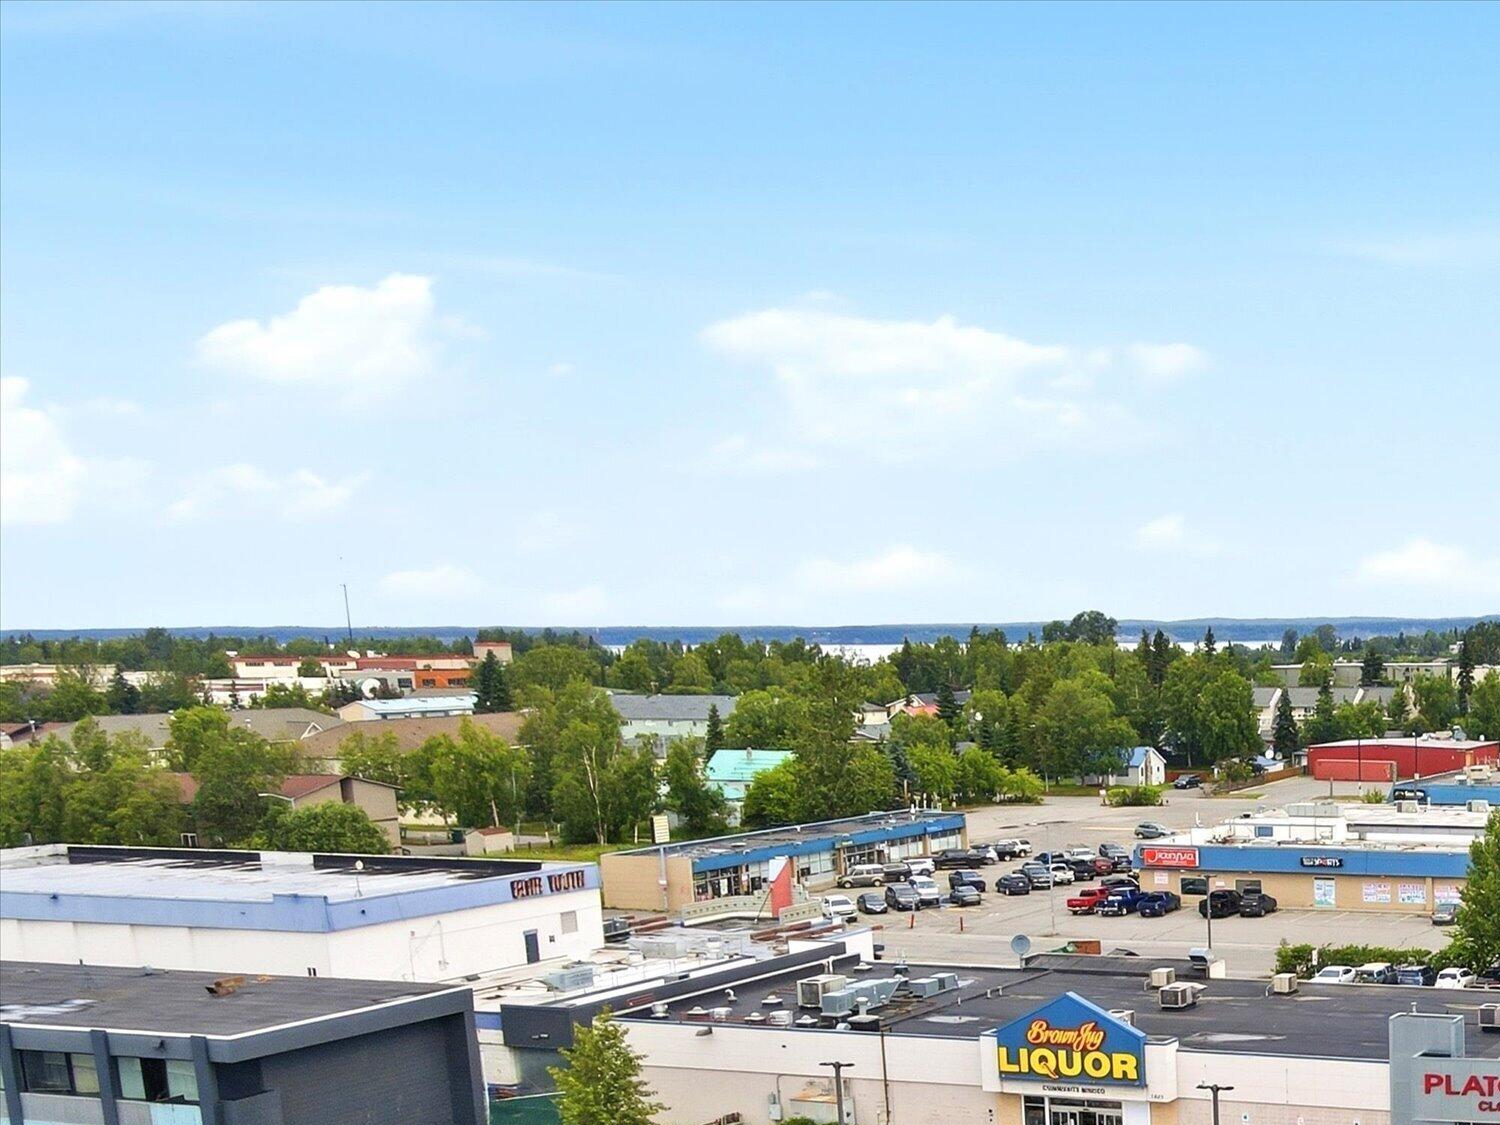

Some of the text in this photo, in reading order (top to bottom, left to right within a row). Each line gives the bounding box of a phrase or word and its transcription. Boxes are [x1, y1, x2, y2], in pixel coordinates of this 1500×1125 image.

[1027, 1019, 1105, 1051] Brown Jug
[999, 1046, 1139, 1080] LIQUOR
